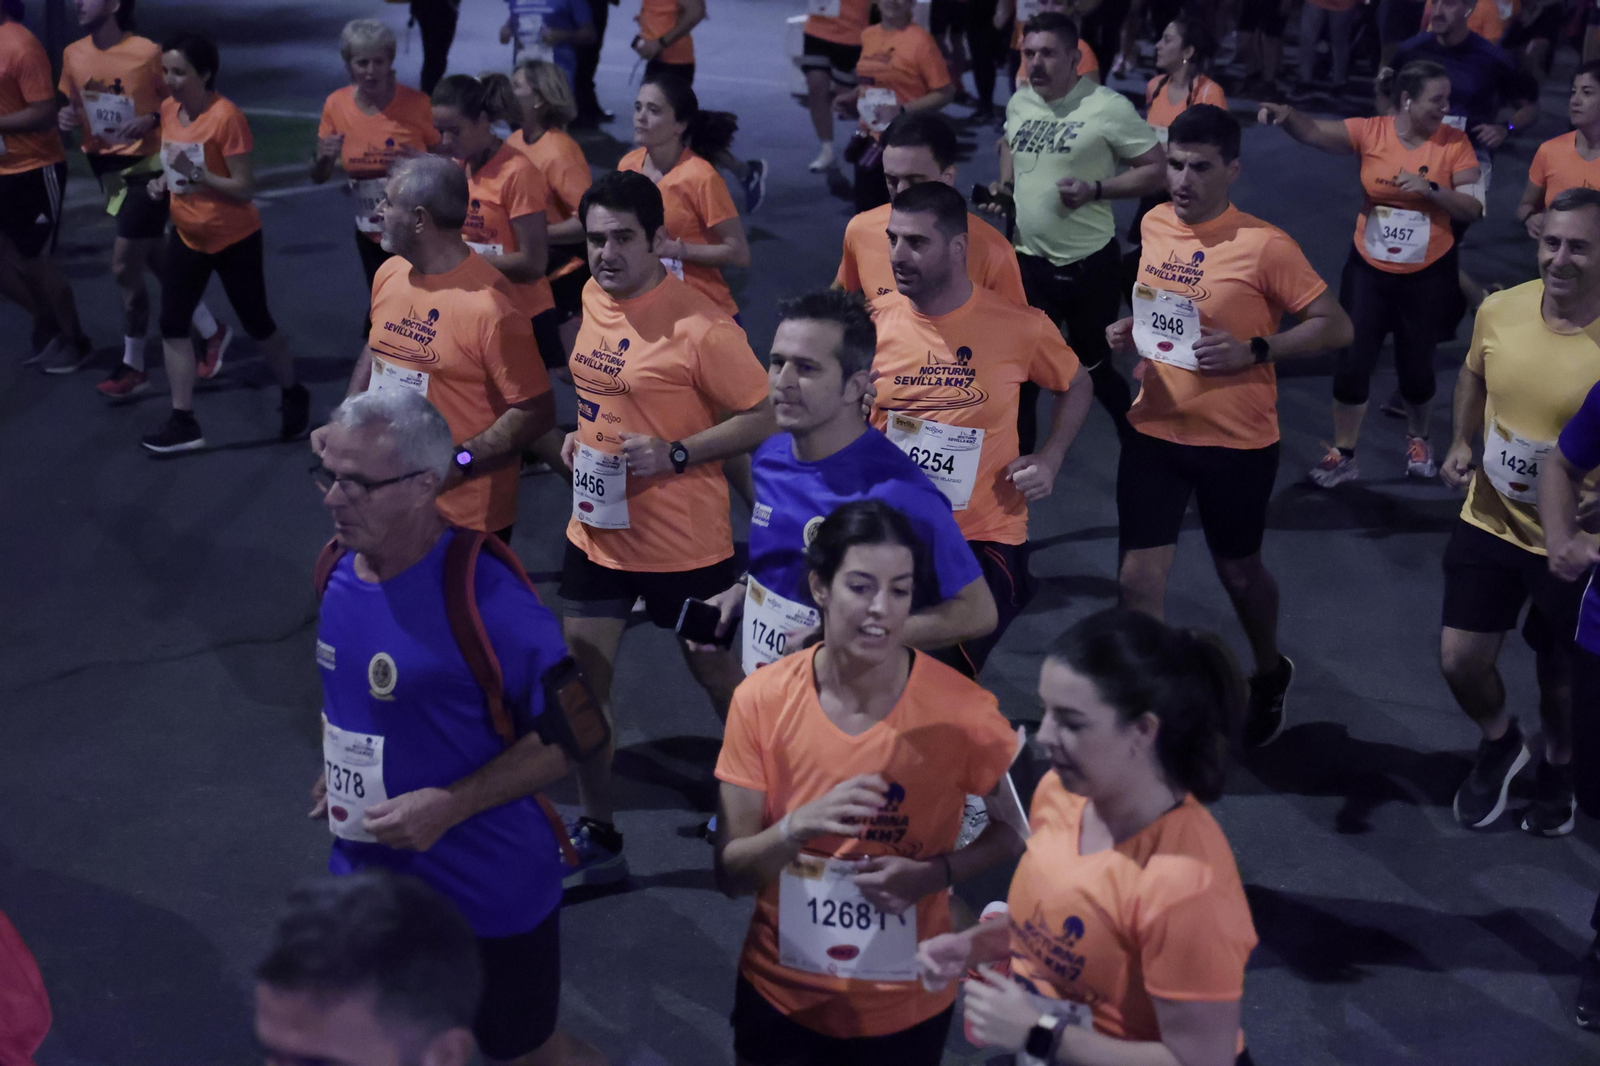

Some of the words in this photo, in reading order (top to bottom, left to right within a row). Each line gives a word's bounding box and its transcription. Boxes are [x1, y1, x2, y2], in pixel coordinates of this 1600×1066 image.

[1010, 119, 1085, 154] NIKE
[1383, 225, 1414, 241] 3457
[1145, 264, 1177, 282] SEVILLA
[1161, 262, 1204, 277] NOCTURNA
[383, 321, 413, 339] SEVILLA
[401, 318, 437, 338] NOCTURNA
[1151, 311, 1184, 336] 2948
[574, 352, 602, 371] SEVILLA
[591, 349, 626, 368] NOCTURNA
[893, 375, 943, 386] SEVILLA
[919, 366, 976, 377] NOCTURNA
[909, 446, 954, 475] 6254
[1500, 450, 1538, 477] 1424
[575, 468, 605, 497] 3456
[752, 618, 786, 655] 1740
[326, 760, 365, 799] 7378
[807, 896, 886, 931] 12681
